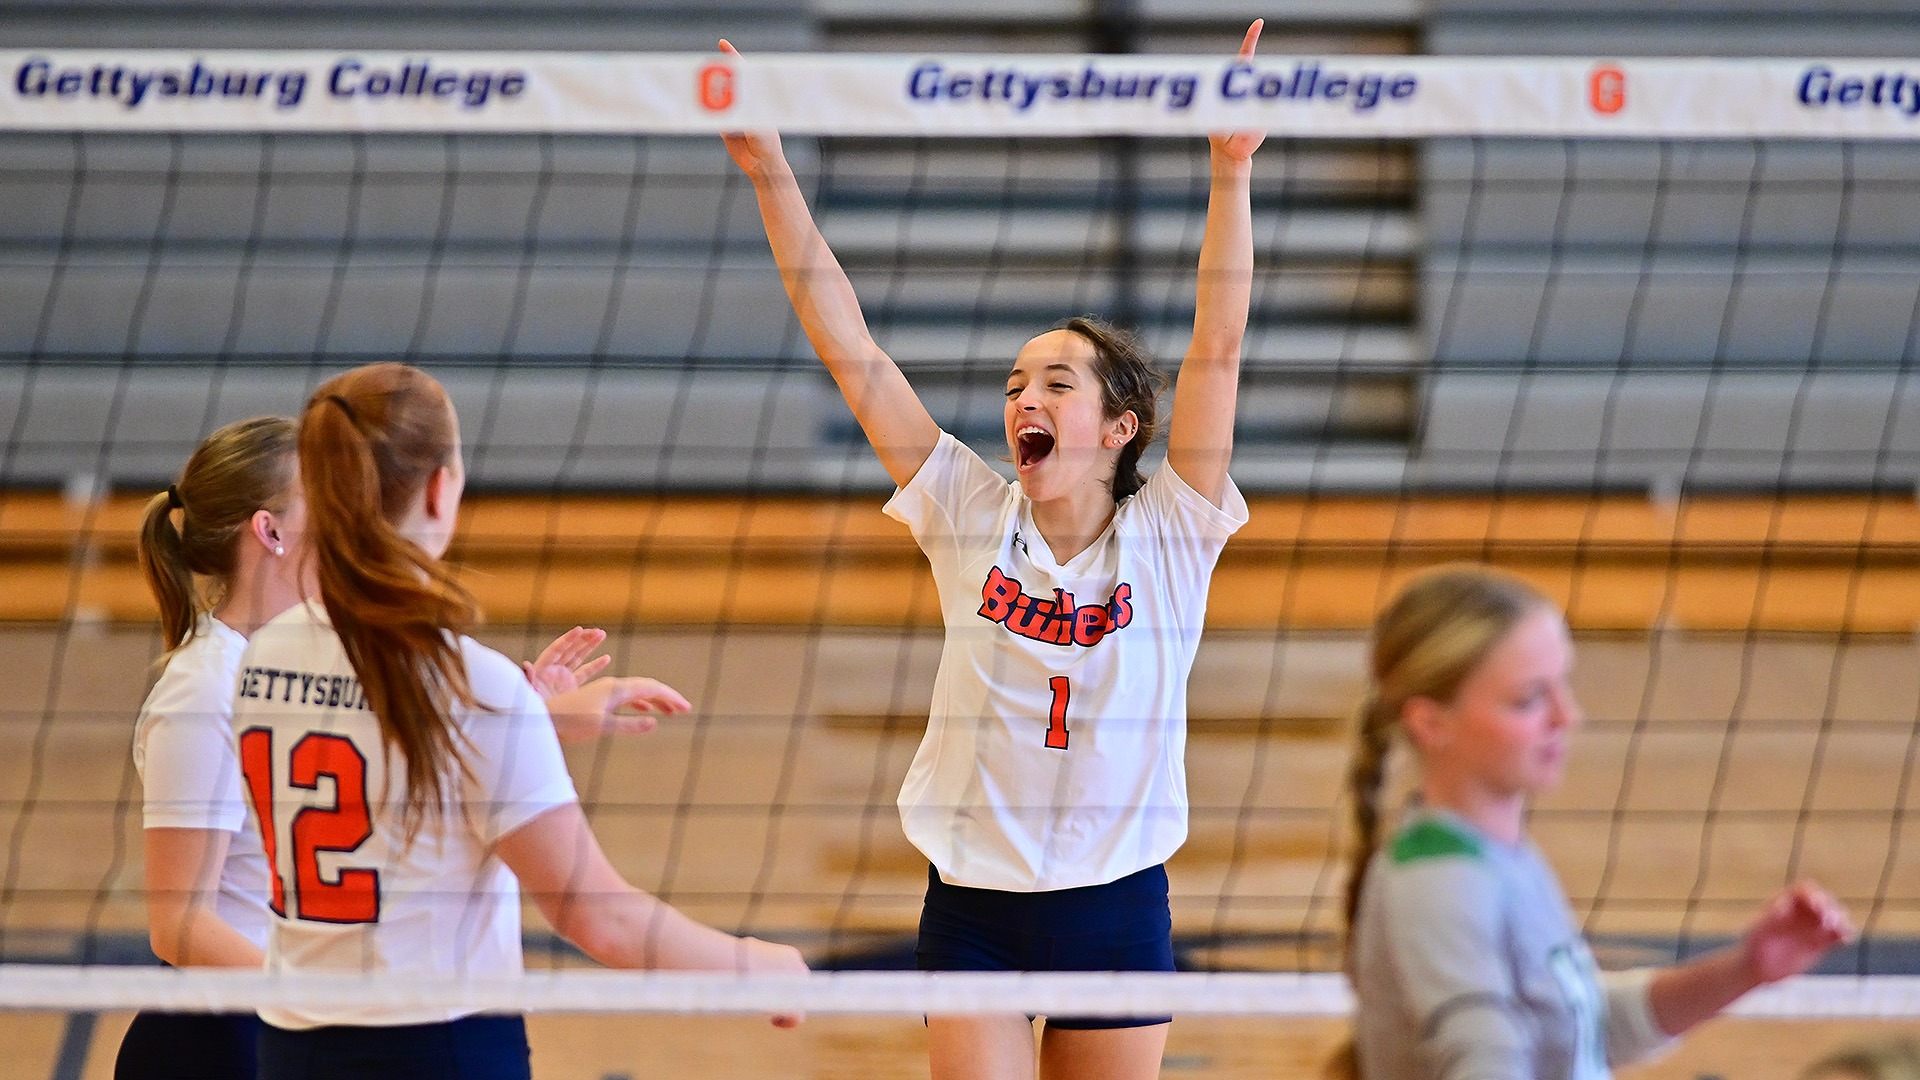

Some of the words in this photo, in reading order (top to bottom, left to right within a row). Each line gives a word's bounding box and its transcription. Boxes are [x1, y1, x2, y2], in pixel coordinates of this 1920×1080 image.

[15, 59, 308, 109] Gettysburg
[327, 59, 527, 109] College
[697, 64, 737, 112] G
[907, 62, 1199, 112] Gettysburg
[1219, 63, 1418, 113] College
[1588, 66, 1627, 116] G
[239, 667, 365, 710] ETTYSBU
[1043, 675, 1071, 750] 1
[240, 726, 380, 924] 12
